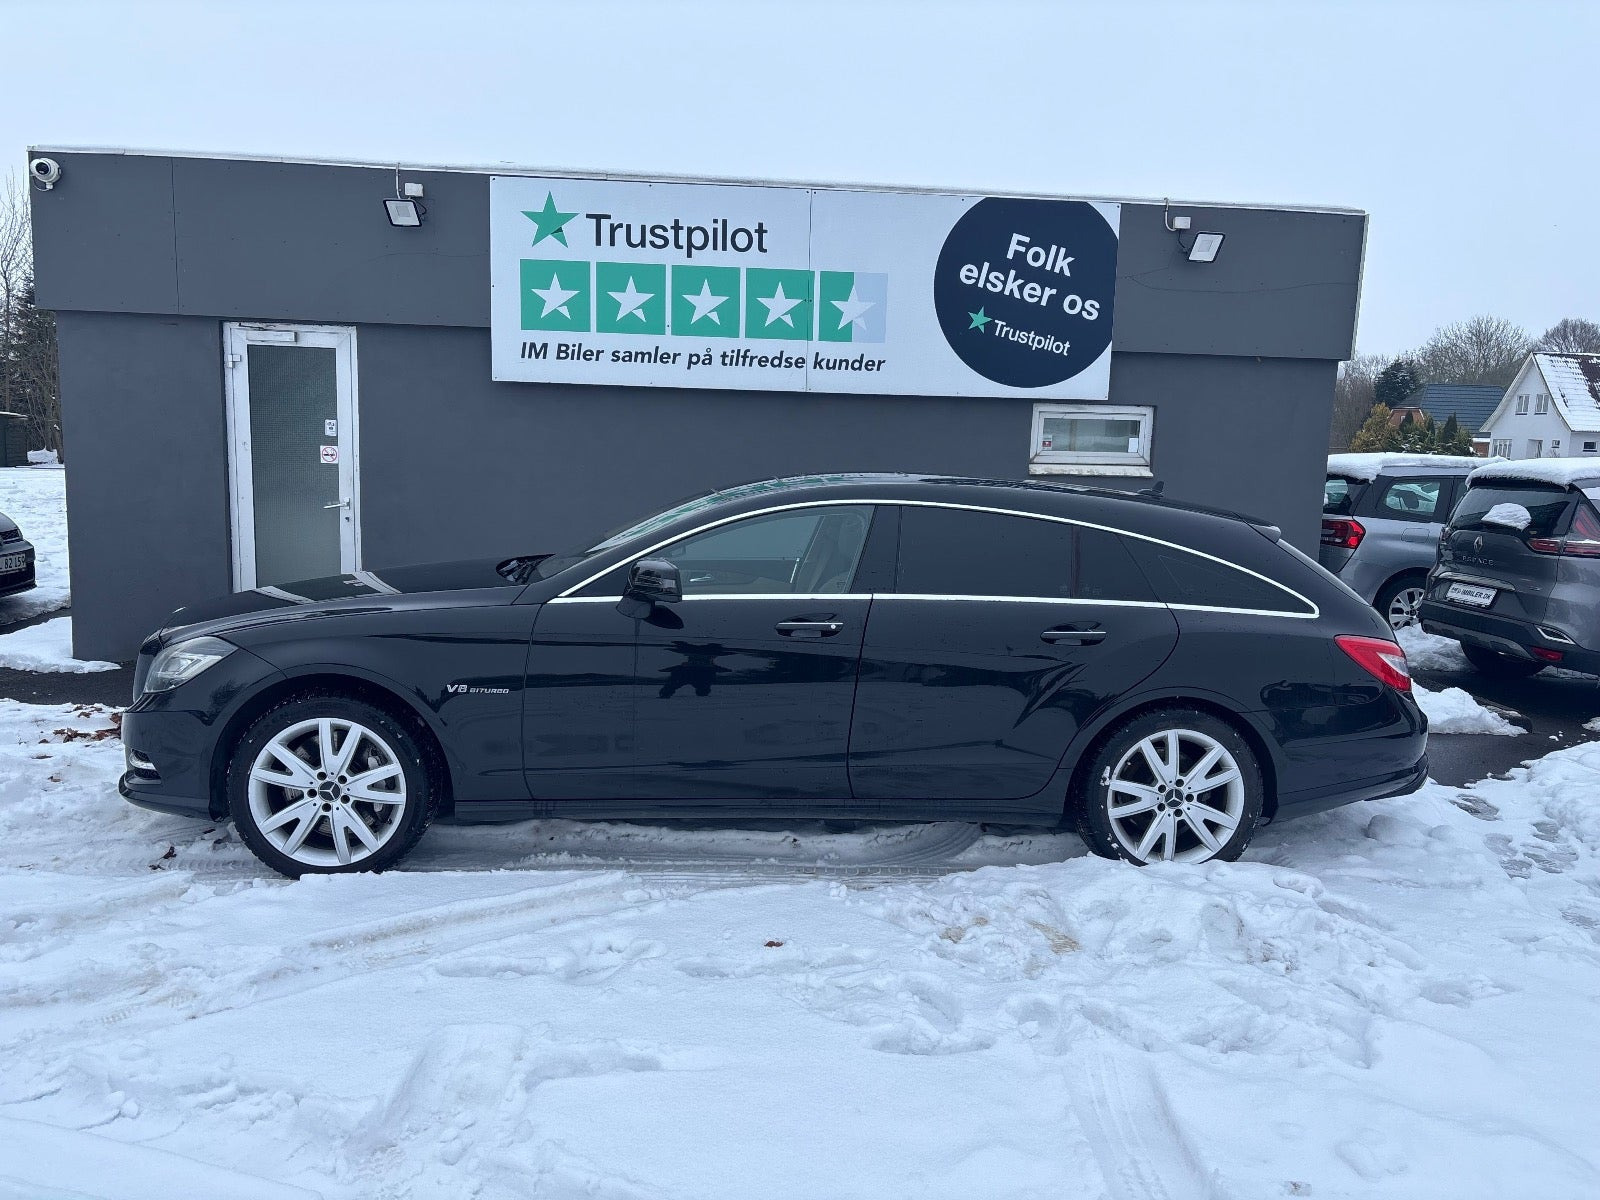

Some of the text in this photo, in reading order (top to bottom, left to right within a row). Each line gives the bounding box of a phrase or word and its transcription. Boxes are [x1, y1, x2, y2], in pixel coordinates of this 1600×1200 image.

[585, 213, 768, 258] Trustpilot
[1006, 232, 1075, 277] Folk
[959, 262, 1101, 321] elsker os
[993, 319, 1071, 356] Trustpilot
[520, 341, 886, 372] IM Biler samler på tilfredse kunder
[5, 557, 13, 569] 82
[446, 684, 468, 693] V8
